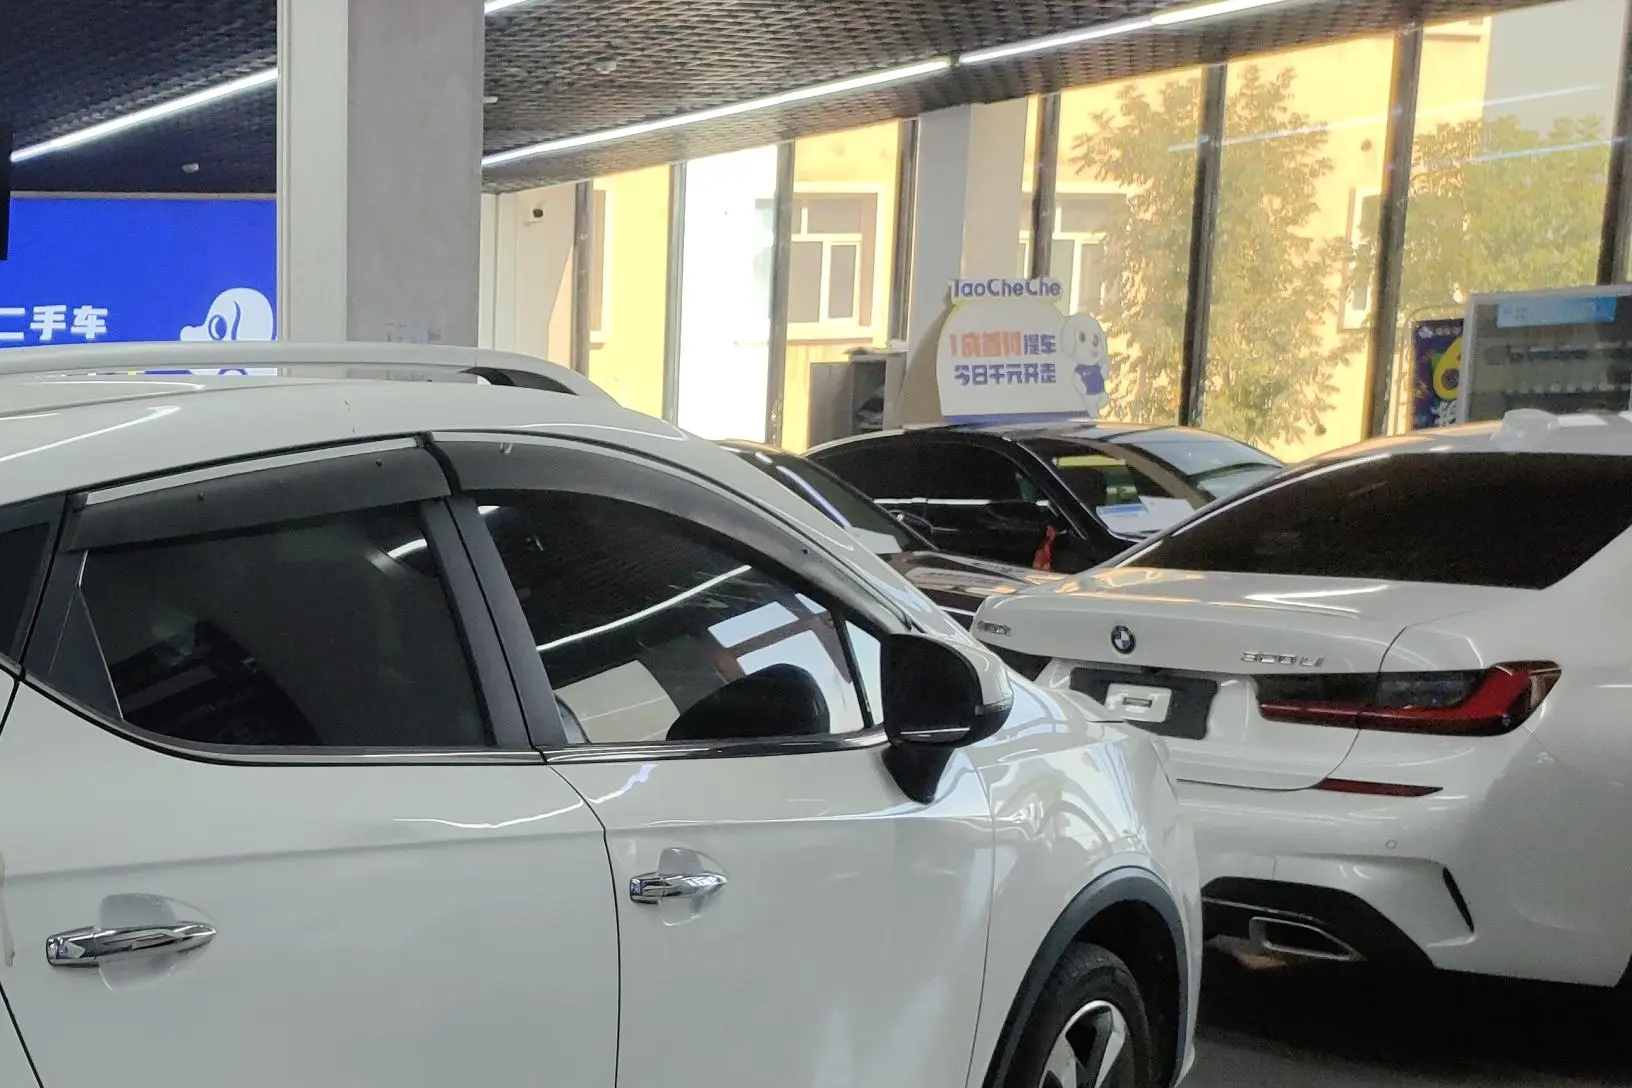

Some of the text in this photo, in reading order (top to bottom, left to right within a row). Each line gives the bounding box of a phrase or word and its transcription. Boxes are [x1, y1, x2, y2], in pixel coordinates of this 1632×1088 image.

[954, 362, 1057, 386] 今日千元开走
